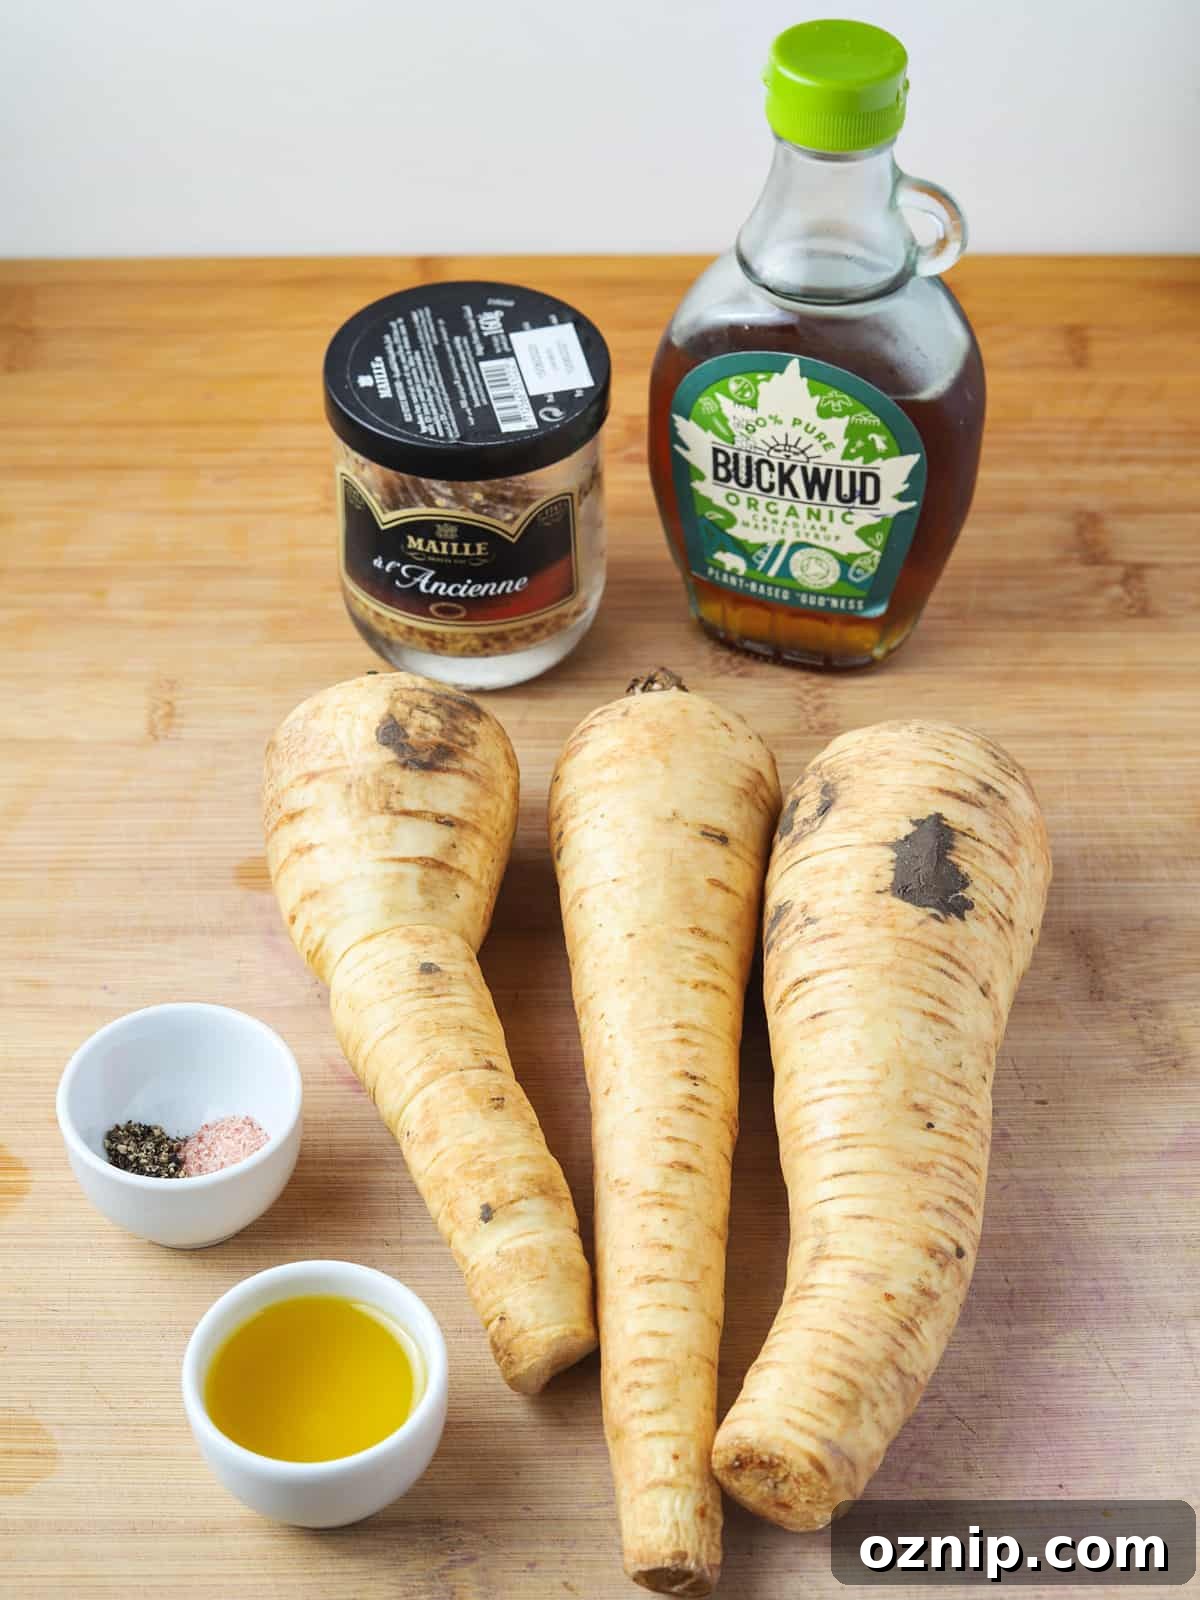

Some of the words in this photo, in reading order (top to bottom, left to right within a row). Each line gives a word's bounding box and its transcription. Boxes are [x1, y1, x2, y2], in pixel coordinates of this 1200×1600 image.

[792, 417, 836, 452] PURE
[711, 446, 881, 506] BUCKWUD
[725, 492, 855, 525] ORGANIC
[407, 535, 489, 557] MAILLE
[707, 567, 790, 601] PLANT-BASED
